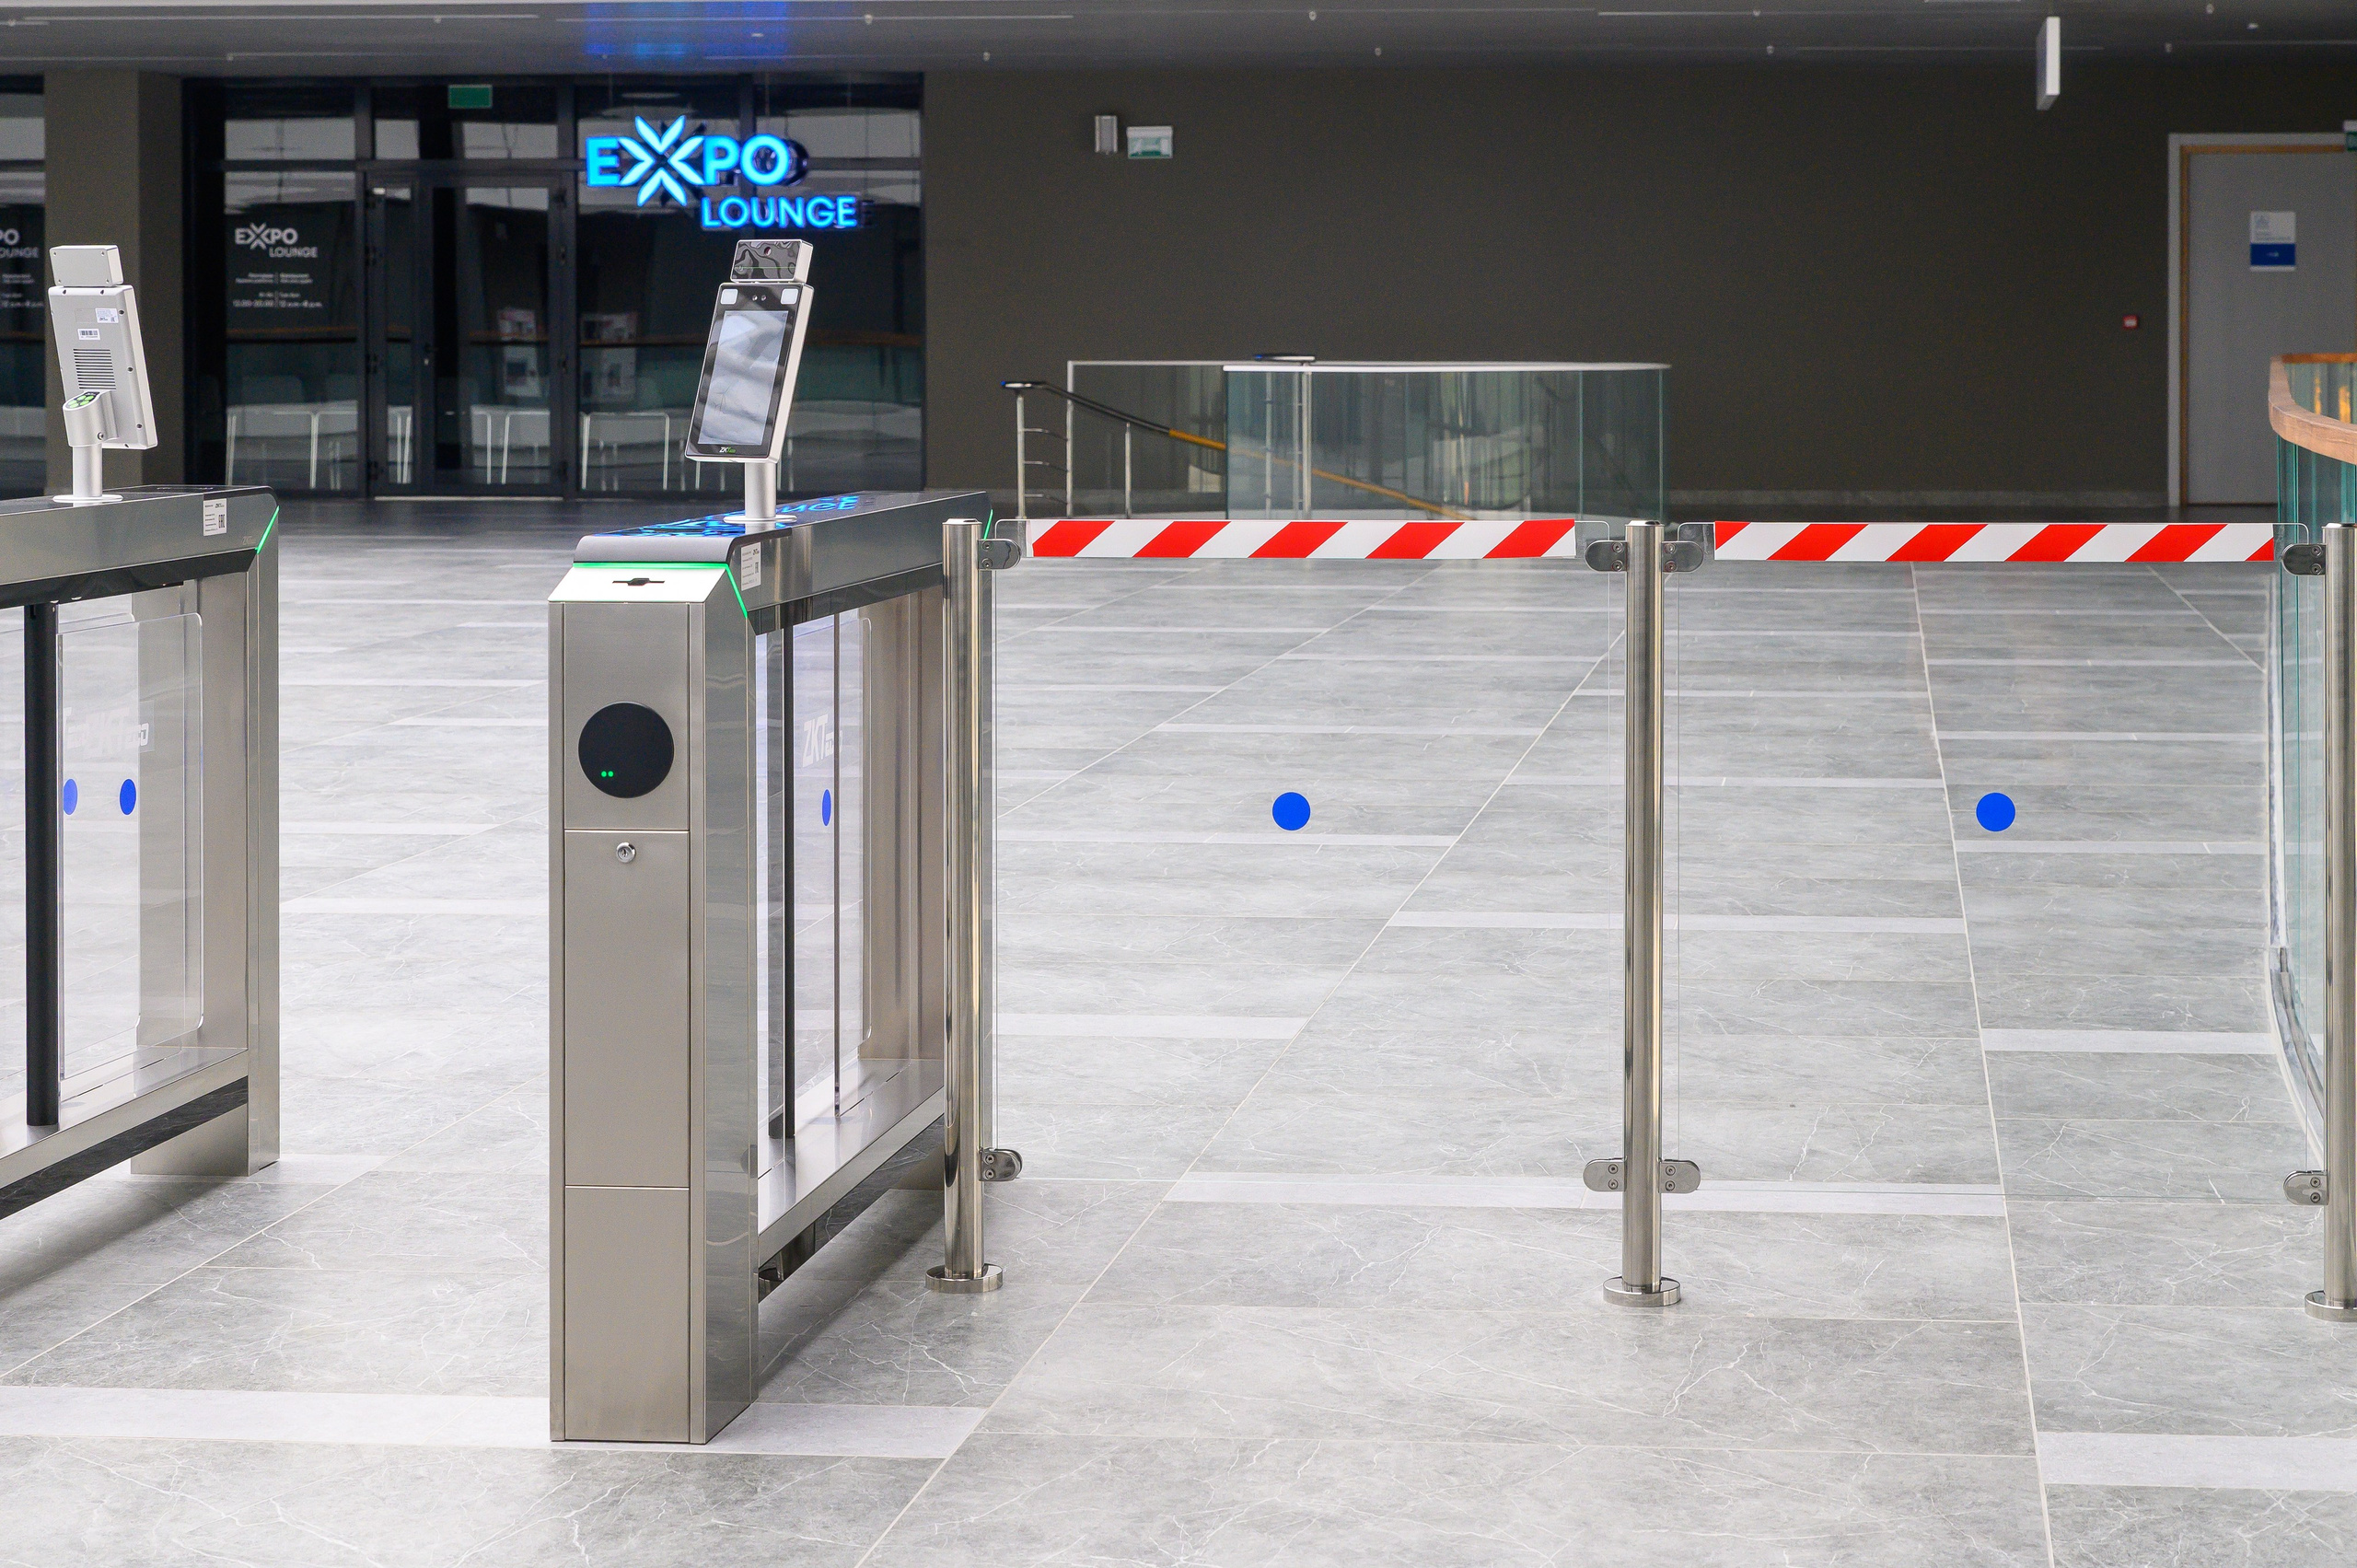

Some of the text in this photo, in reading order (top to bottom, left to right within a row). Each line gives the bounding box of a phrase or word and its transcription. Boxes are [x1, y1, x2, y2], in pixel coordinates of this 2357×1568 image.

[586, 115, 790, 207] EXPO
[701, 195, 858, 228] LOUNGE
[234, 223, 298, 250] EXPO
[0, 247, 39, 258] OUNGE
[269, 247, 319, 258] LOUNGE
